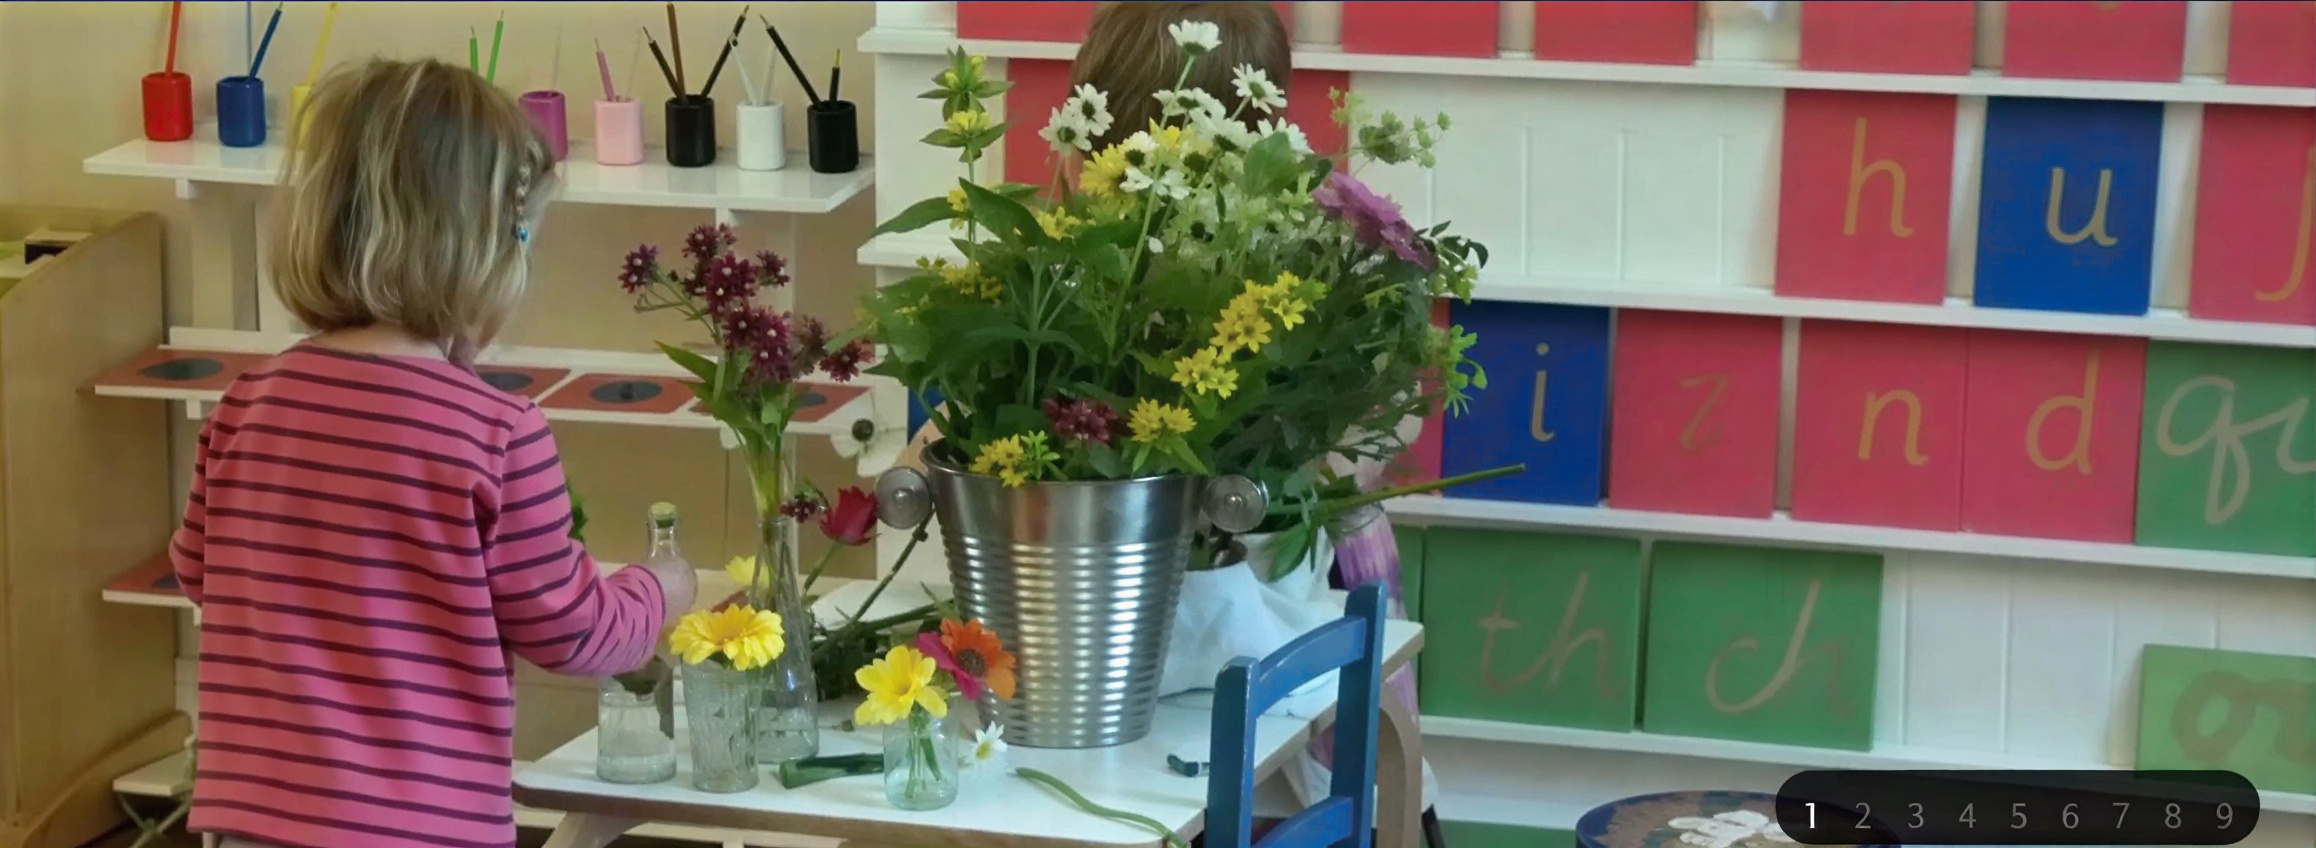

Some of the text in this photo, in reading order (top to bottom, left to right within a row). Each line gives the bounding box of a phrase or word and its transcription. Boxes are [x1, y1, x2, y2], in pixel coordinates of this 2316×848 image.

[1843, 117, 1914, 238] h
[2045, 166, 2118, 247] u
[1529, 343, 1555, 442] i
[1858, 388, 1930, 466] n
[2025, 348, 2100, 476] d
[1478, 569, 1626, 702] th
[1706, 579, 1856, 717] ch
